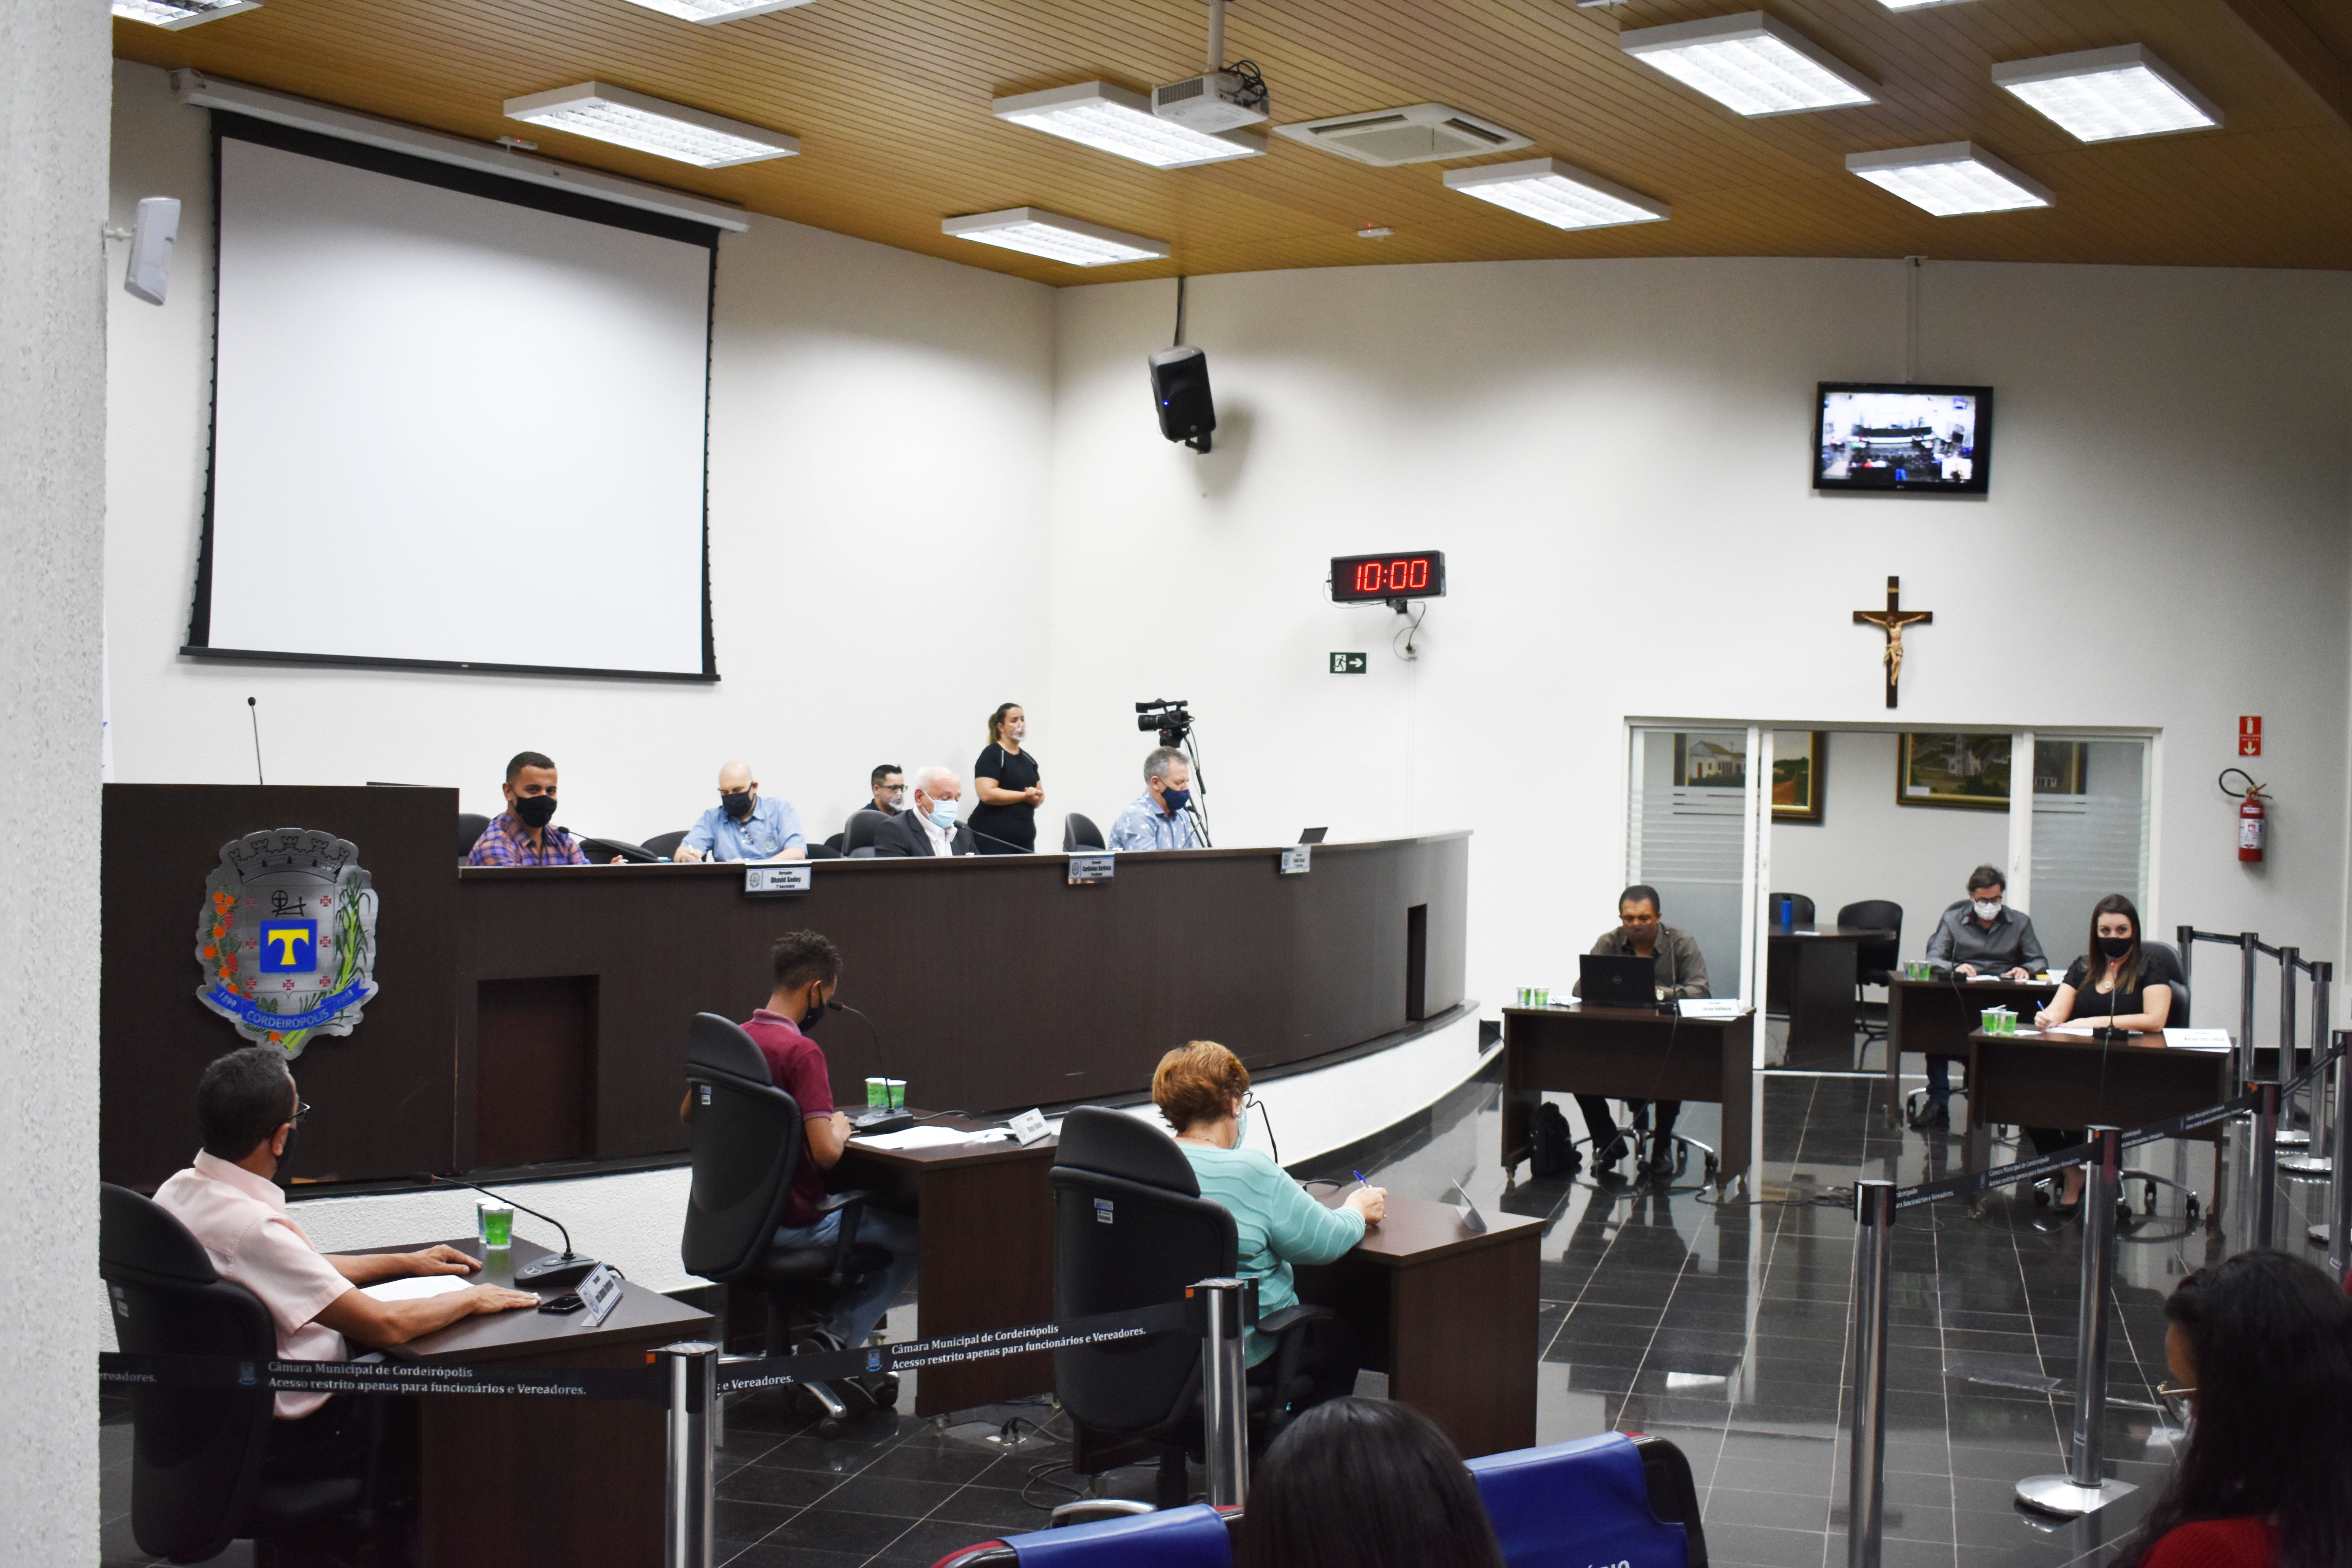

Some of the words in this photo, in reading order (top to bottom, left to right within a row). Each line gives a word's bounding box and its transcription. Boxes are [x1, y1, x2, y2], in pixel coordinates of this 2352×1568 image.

[1356, 560, 1427, 591] 10:00
[218, 992, 237, 1007] 1899
[247, 1009, 329, 1027] CORDEIRÓPOLIS
[892, 1344, 929, 1354] Câmara
[932, 1334, 979, 1349] Municipal
[981, 1333, 993, 1343] de
[995, 1325, 1058, 1341] Cordeirópolis
[892, 1359, 926, 1370] Acesso
[928, 1352, 964, 1365] restrito
[966, 1348, 1000, 1361] apenas
[1002, 1345, 1023, 1357] para
[1026, 1336, 1084, 1351] funcionários
[1093, 1328, 1146, 1341] Vereadores.
[268, 1361, 312, 1372] Câmara
[315, 1363, 373, 1377] Municipal
[376, 1365, 390, 1375] de
[392, 1365, 473, 1379] Cordeirópolis
[269, 1377, 308, 1387] Acesso
[310, 1380, 355, 1389] restrito
[357, 1381, 399, 1393] apenas
[401, 1383, 428, 1394] para
[431, 1381, 505, 1394] funcionários
[517, 1384, 586, 1395] Vereadores.
[731, 1375, 794, 1389] Vereadores.
